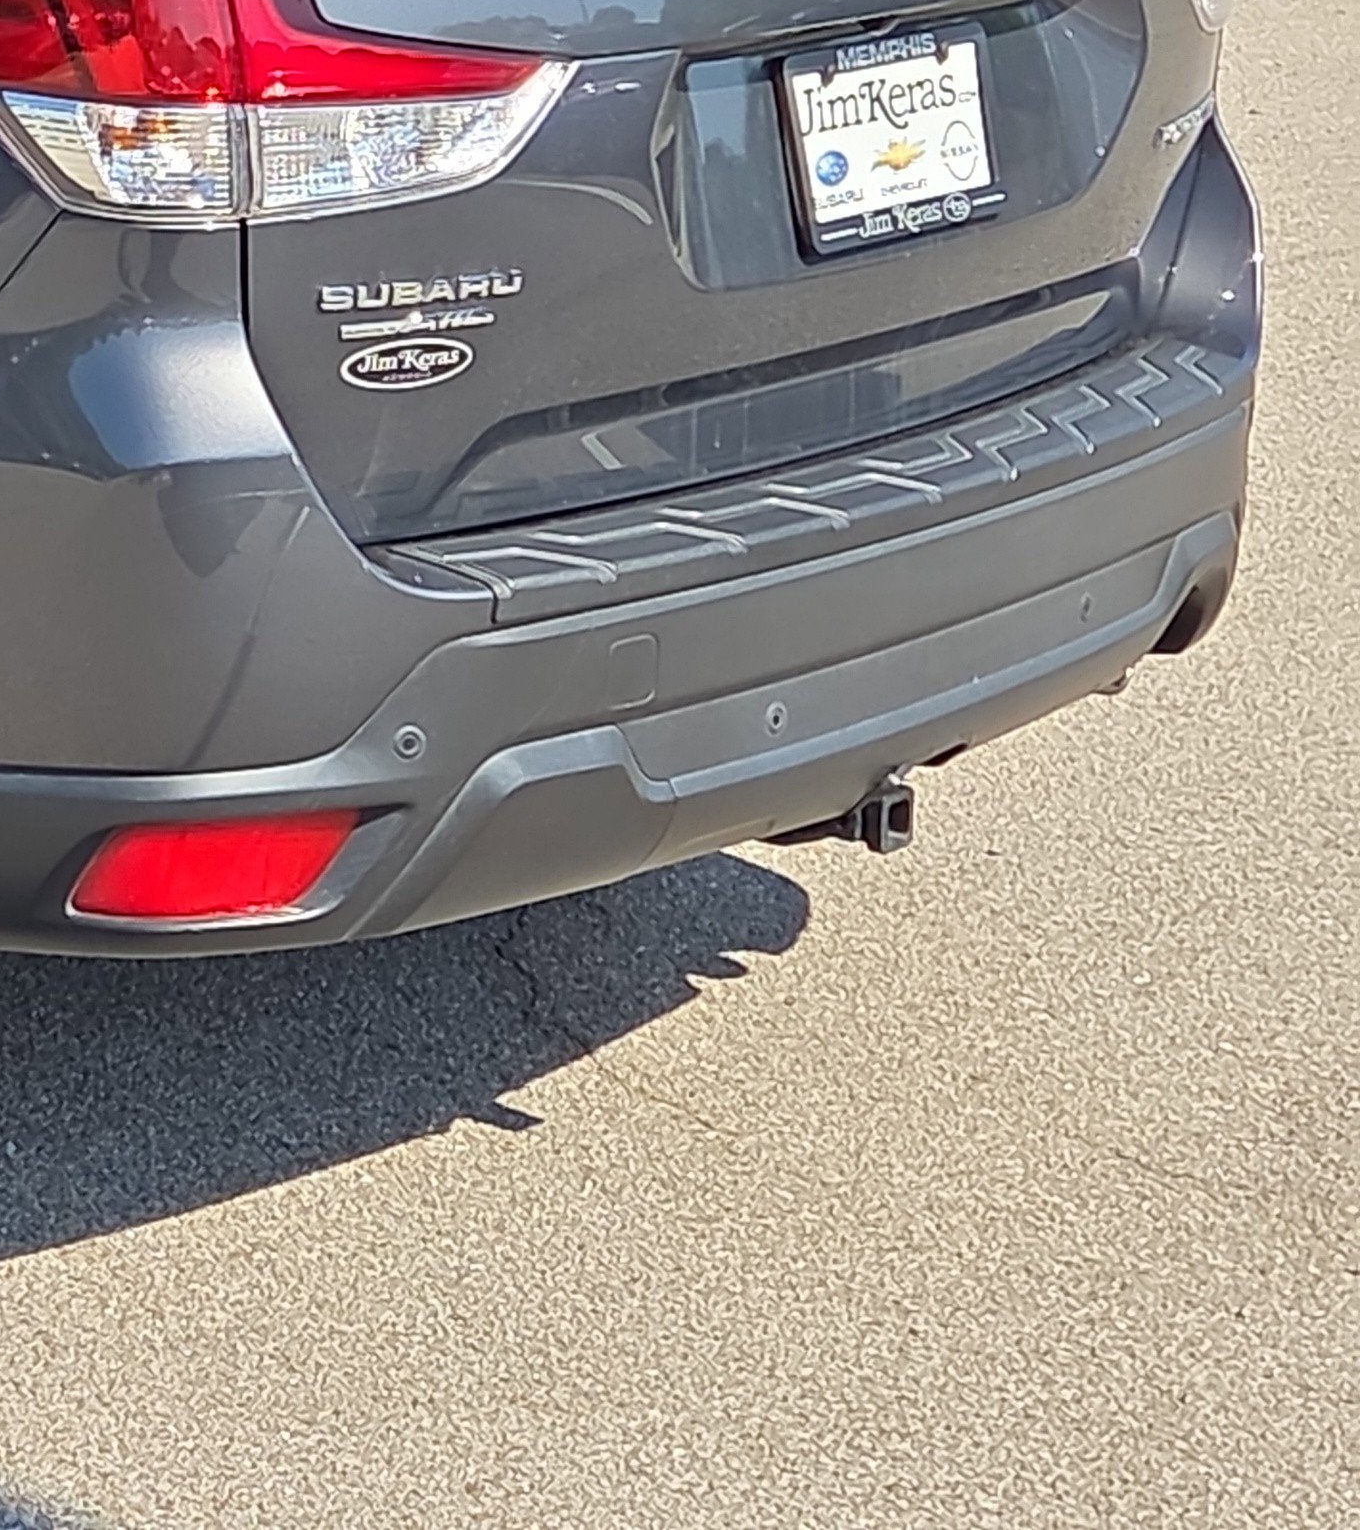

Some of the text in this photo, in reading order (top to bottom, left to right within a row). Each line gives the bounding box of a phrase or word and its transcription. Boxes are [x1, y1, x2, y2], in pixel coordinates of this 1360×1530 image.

[836, 33, 937, 70] MEMPHIS
[859, 211, 894, 238] Jim
[891, 201, 942, 233] Keras
[318, 267, 523, 311] SUBARU
